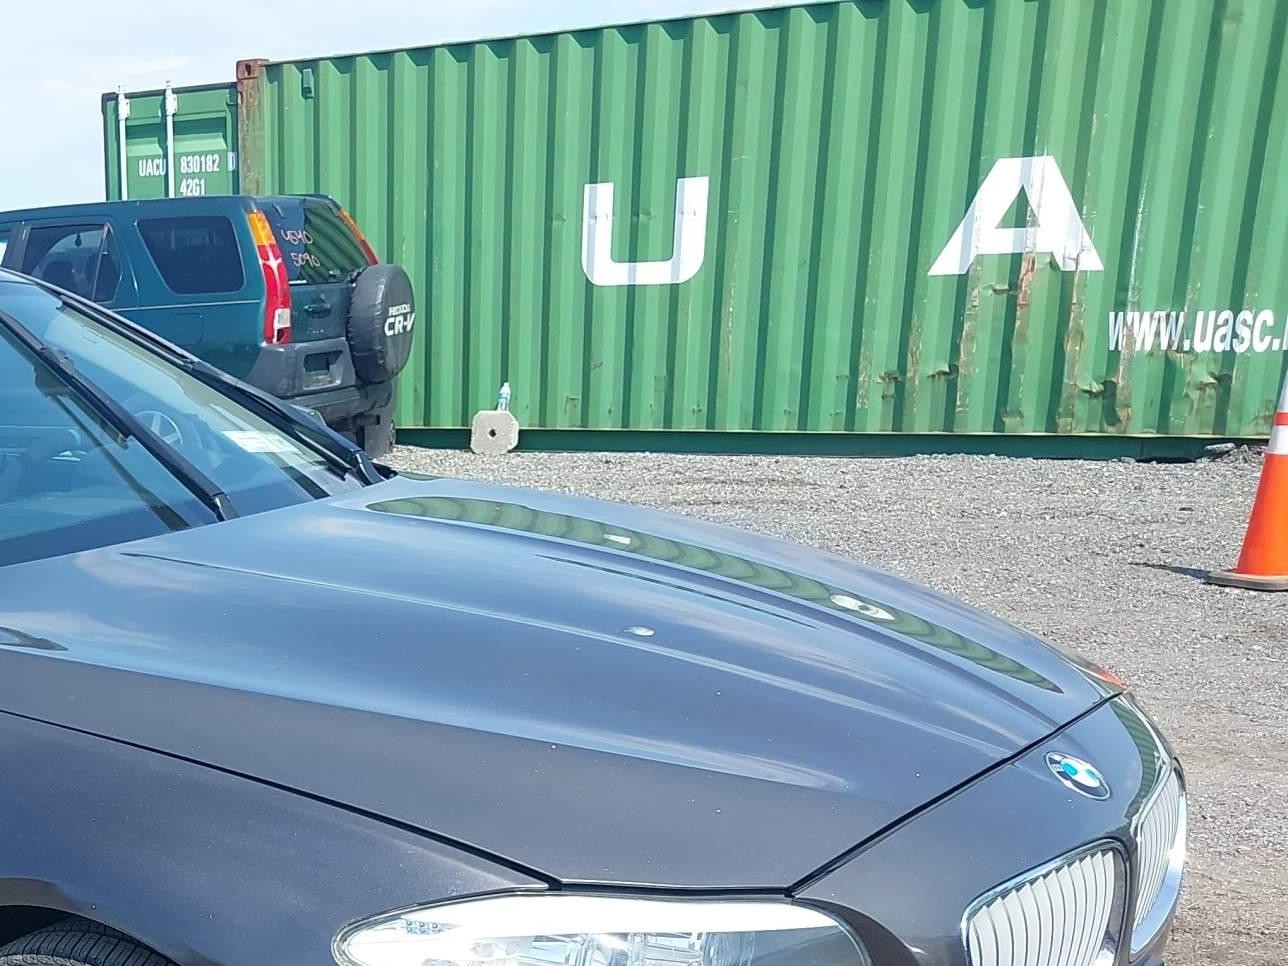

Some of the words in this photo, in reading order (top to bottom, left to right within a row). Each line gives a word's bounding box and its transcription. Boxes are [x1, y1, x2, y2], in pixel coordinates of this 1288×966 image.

[138, 158, 167, 177] UACU
[180, 154, 220, 174] 830182
[179, 178, 205, 196] 42G1
[580, 175, 710, 287] U
[927, 155, 1104, 276] A
[384, 313, 416, 336] CR-V
[1109, 309, 1288, 353] www.uasc.
